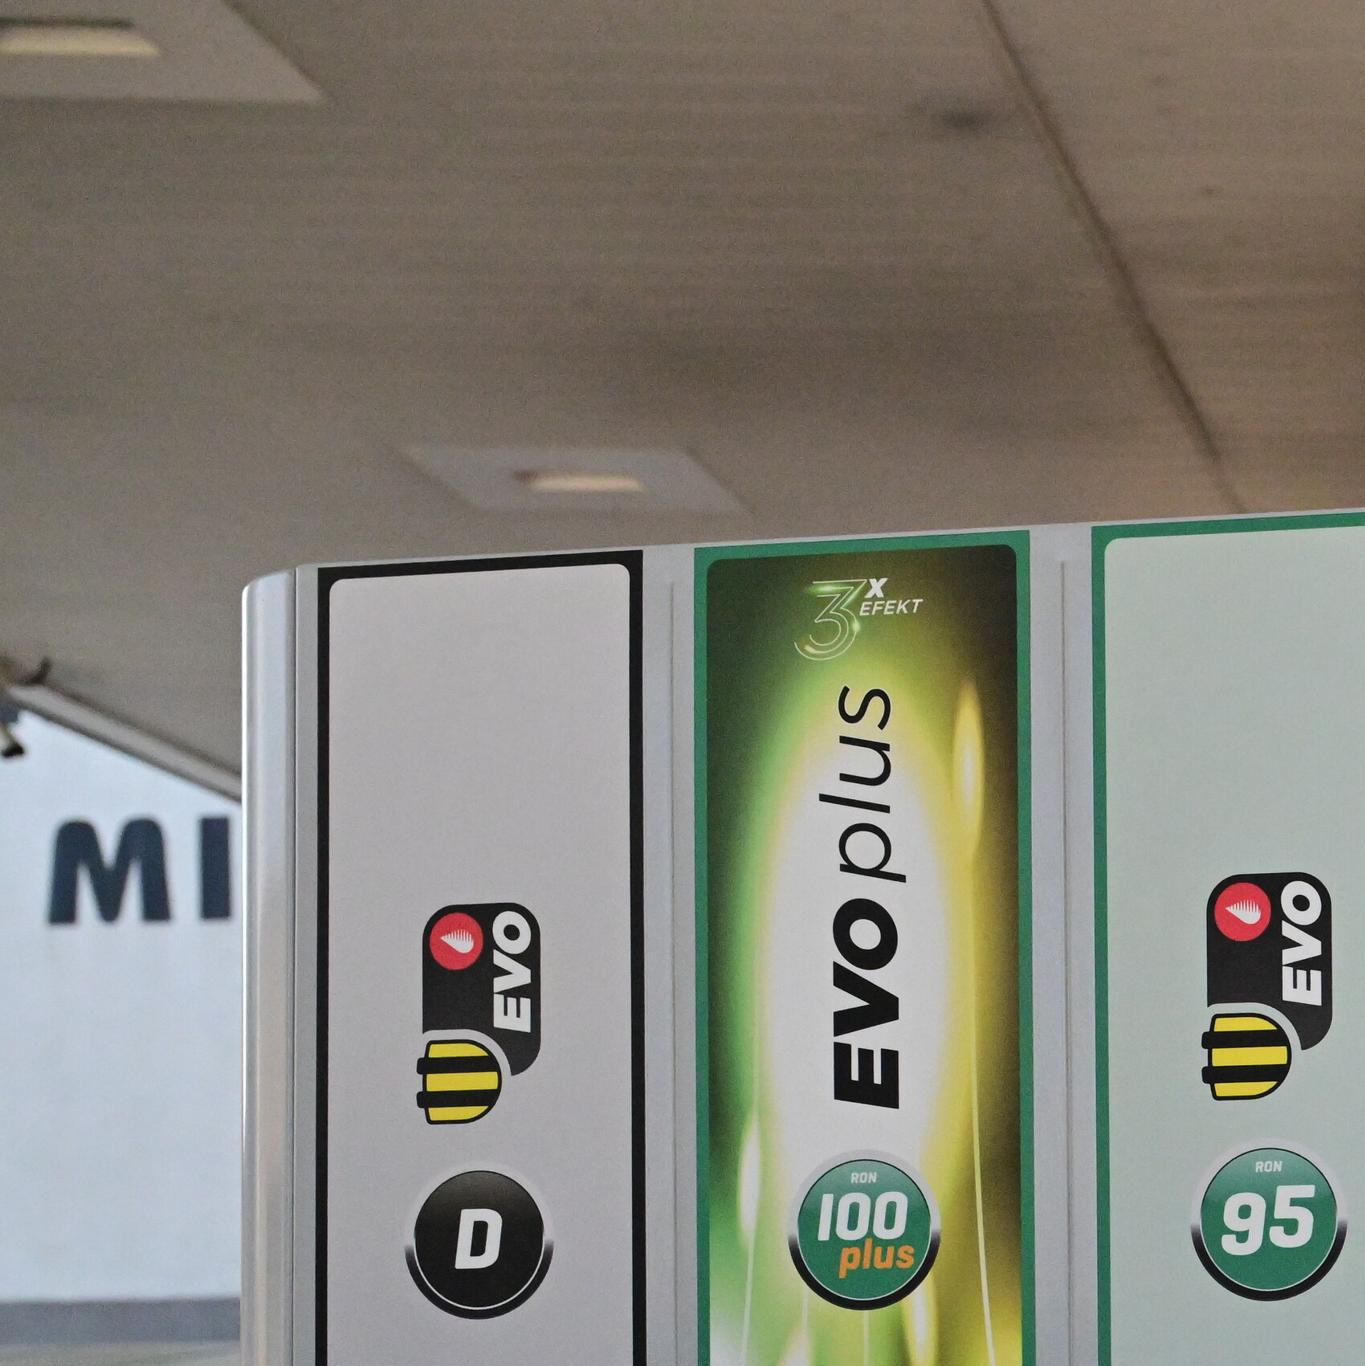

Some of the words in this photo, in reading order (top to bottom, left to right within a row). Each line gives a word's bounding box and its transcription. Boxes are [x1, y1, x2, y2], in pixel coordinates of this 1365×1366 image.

[859, 599, 923, 617] EFEKT
[818, 684, 907, 884] plus
[492, 910, 531, 1033] EVO
[1280, 881, 1322, 1006] EVO
[832, 898, 901, 1109] EVO
[850, 1171, 878, 1185] RON
[1255, 1161, 1282, 1172] RON
[454, 1208, 502, 1269] D
[817, 1193, 908, 1242] 100
[1221, 1185, 1316, 1256] 95
[838, 1238, 915, 1279] plus
